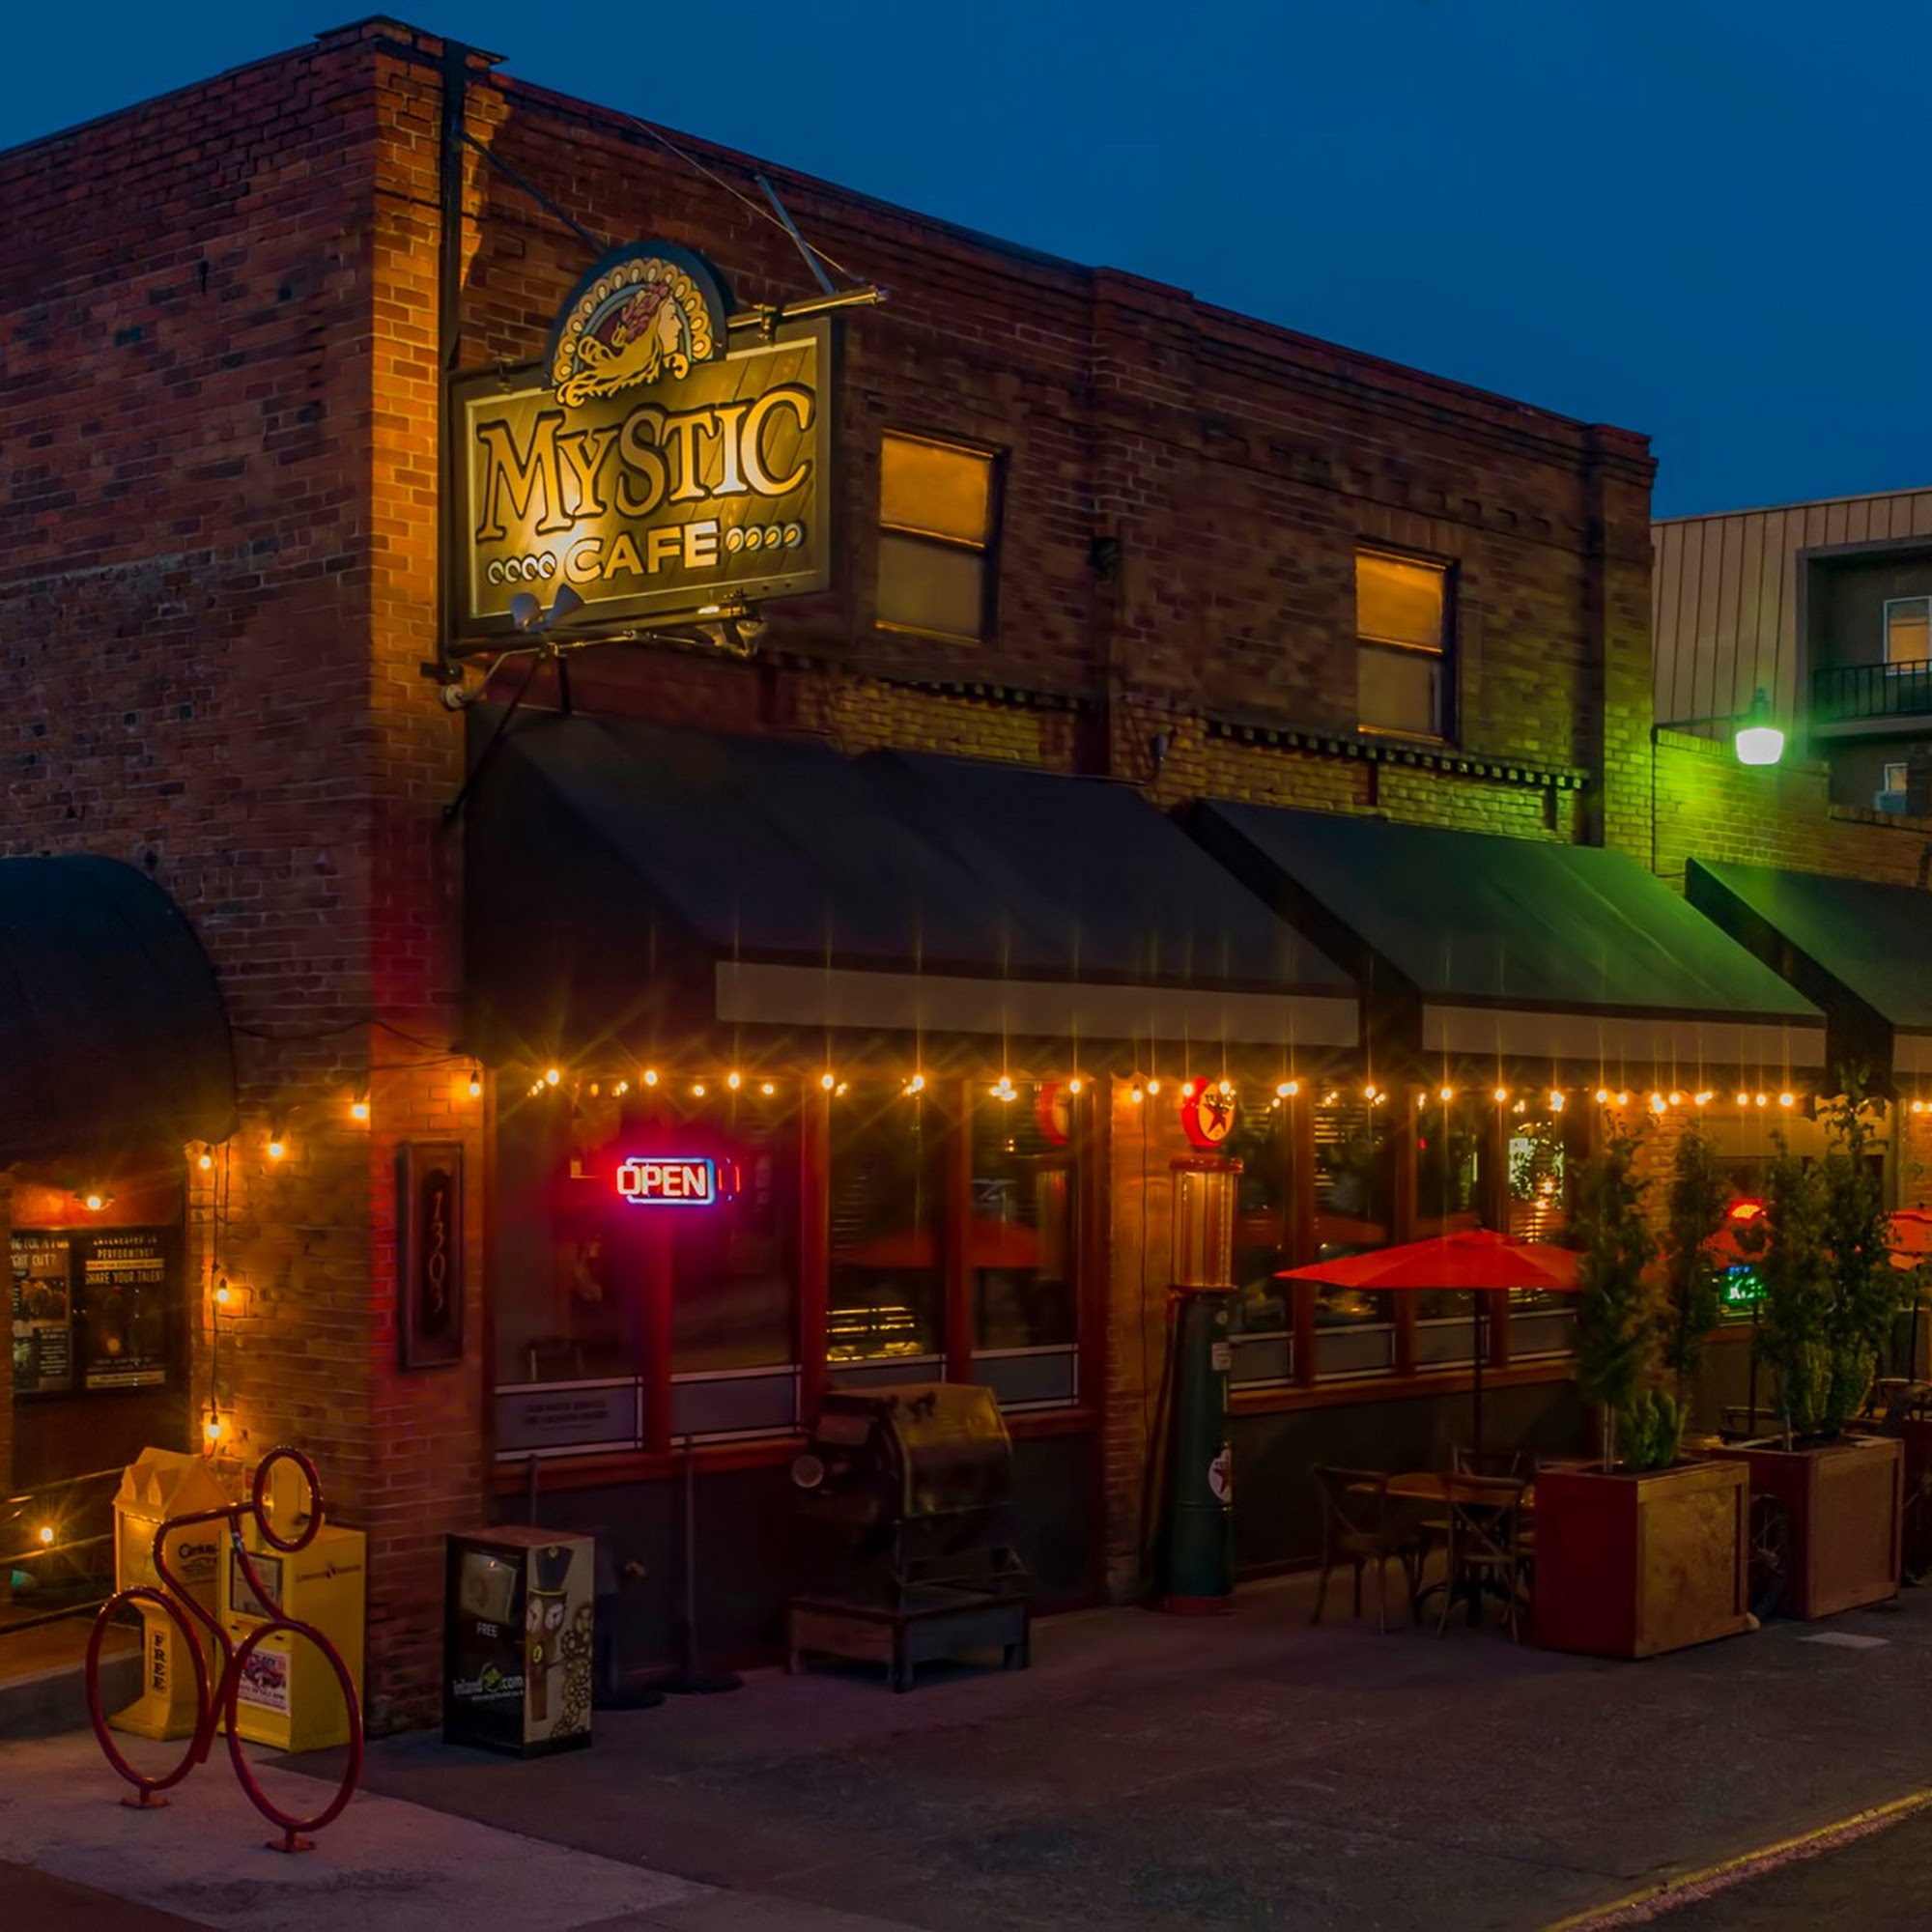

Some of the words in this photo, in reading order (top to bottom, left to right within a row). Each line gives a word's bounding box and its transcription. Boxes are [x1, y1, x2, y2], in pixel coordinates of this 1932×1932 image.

[477, 385, 815, 540] MYSTIC
[564, 518, 720, 583] CAFE
[616, 1164, 707, 1197] OPEN
[476, 1622, 498, 1637] FREE
[152, 1632, 165, 1690] FREE
